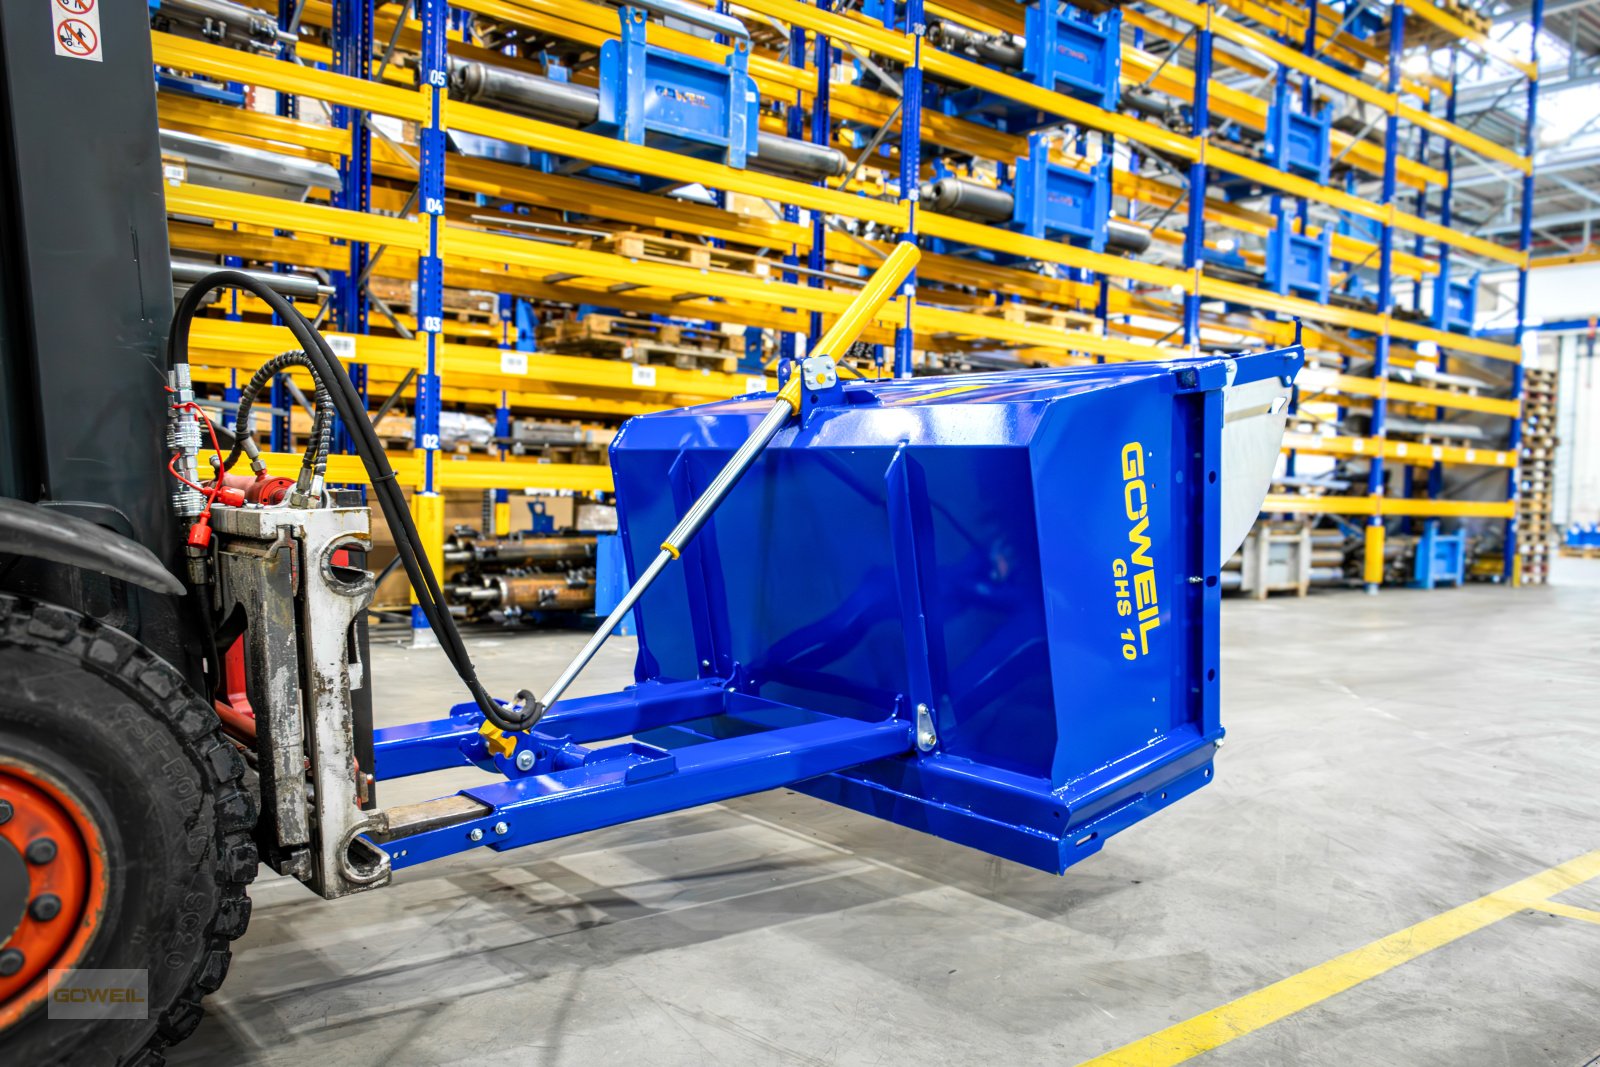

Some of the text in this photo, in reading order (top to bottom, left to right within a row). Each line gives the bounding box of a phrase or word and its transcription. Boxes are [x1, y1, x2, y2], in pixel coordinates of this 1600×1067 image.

[429, 69, 446, 86] 05
[426, 197, 443, 214] 04
[424, 316, 441, 331] 03
[422, 433, 439, 449] 02
[1112, 558, 1137, 661] GHS 10
